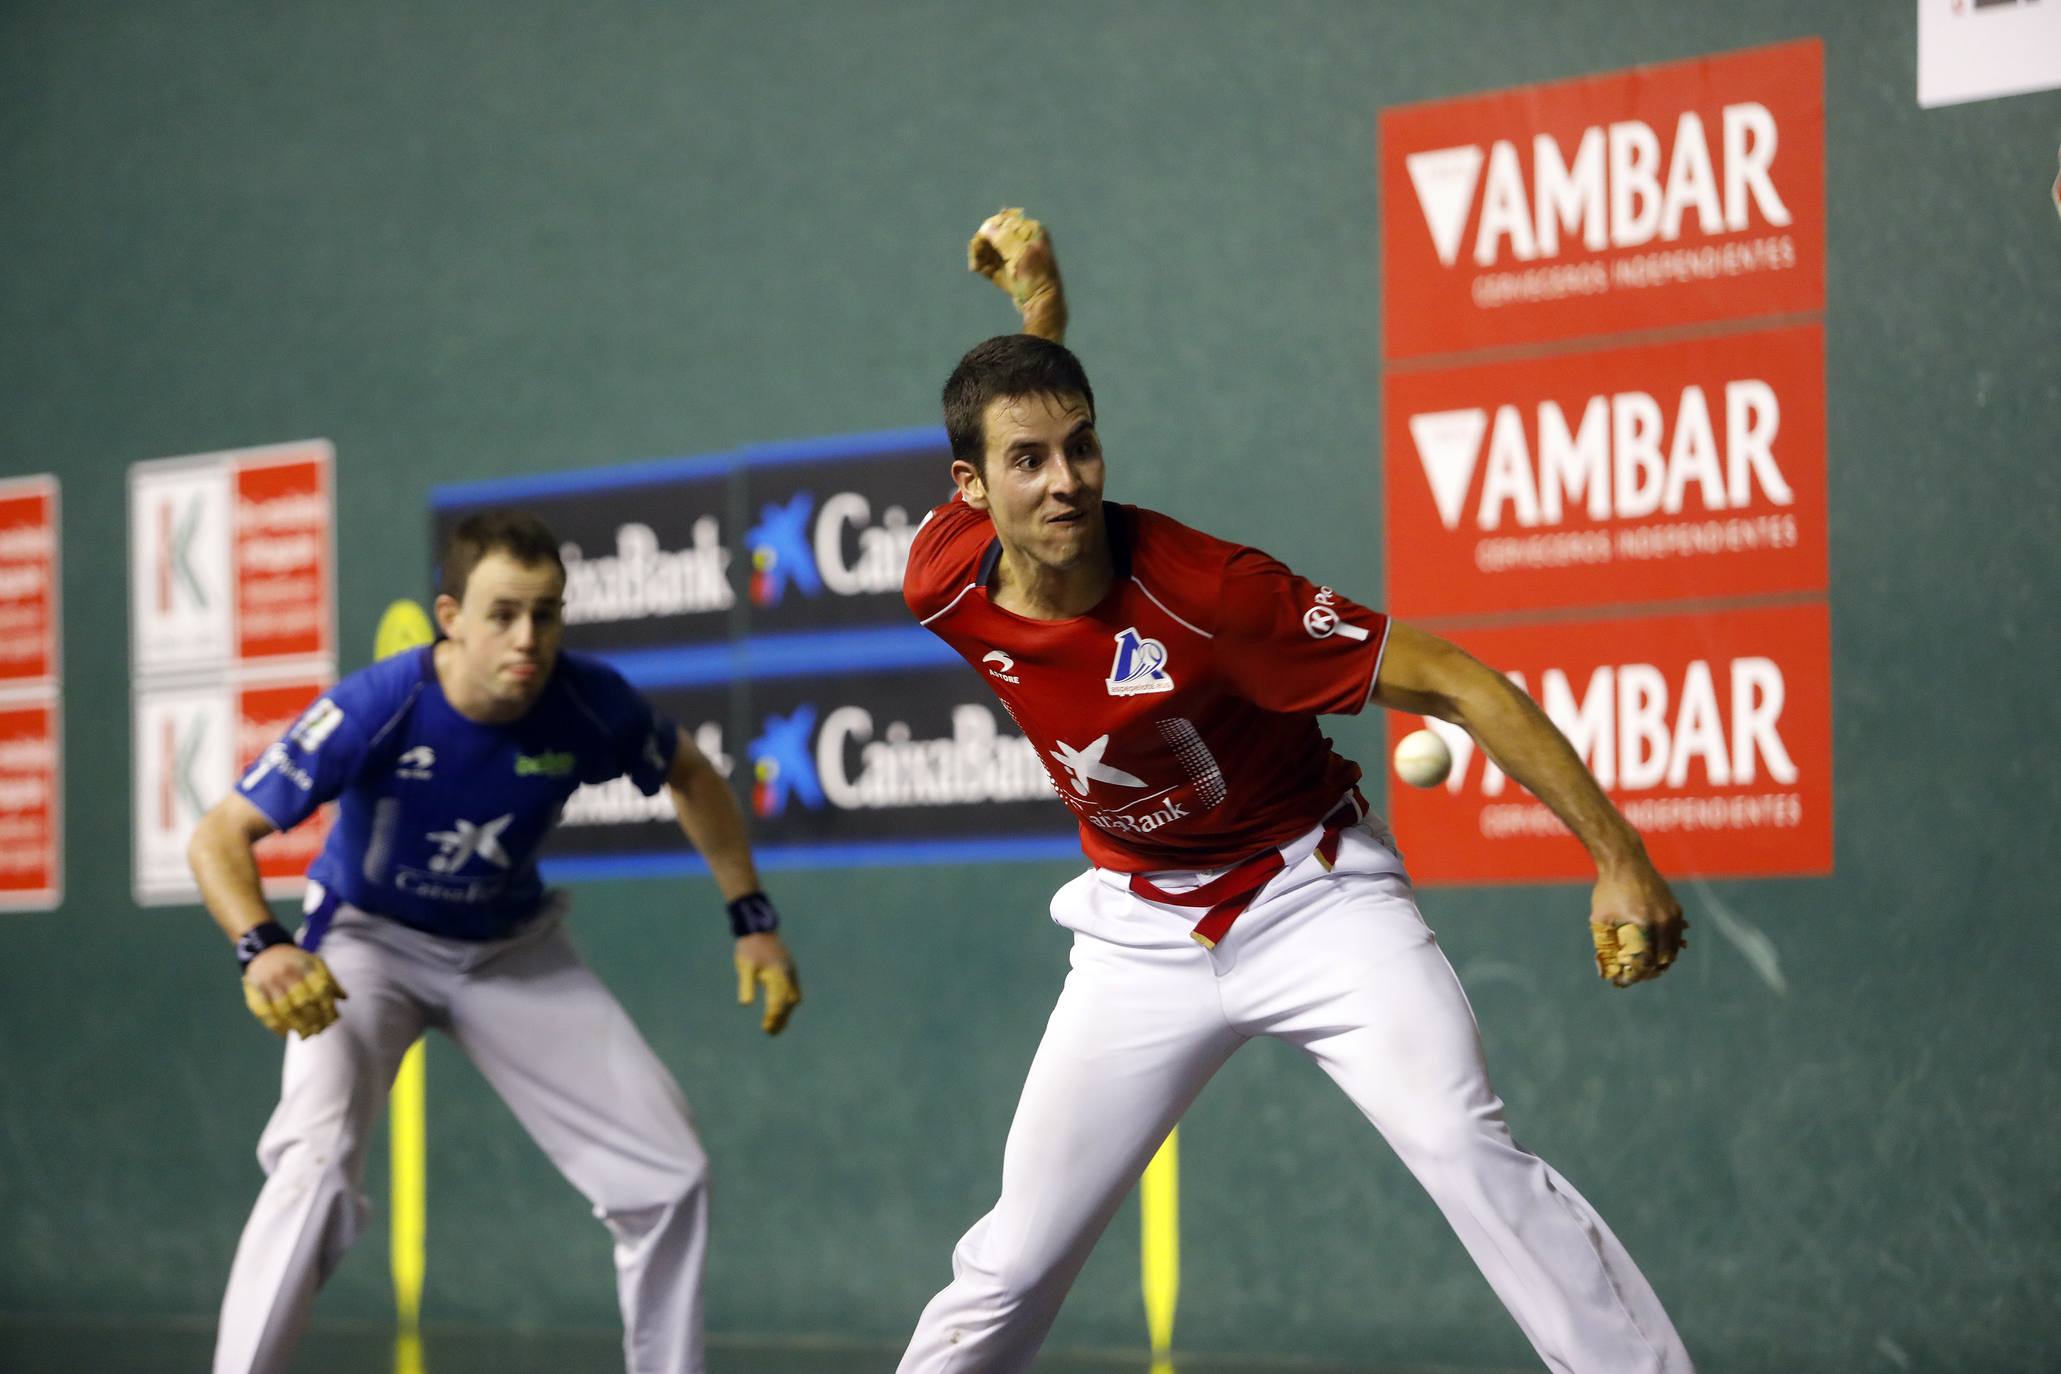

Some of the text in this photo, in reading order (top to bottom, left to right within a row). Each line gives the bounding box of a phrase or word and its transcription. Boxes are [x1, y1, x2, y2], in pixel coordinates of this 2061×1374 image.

[1473, 101, 1792, 267] AMBAR
[1610, 235, 1796, 290] INDEPENDIENTES
[1477, 378, 1794, 531] AMBAR
[561, 515, 737, 625] ixaBank
[1613, 514, 1798, 560] INDEPENDIENTES
[989, 669, 1020, 684] ASTORE
